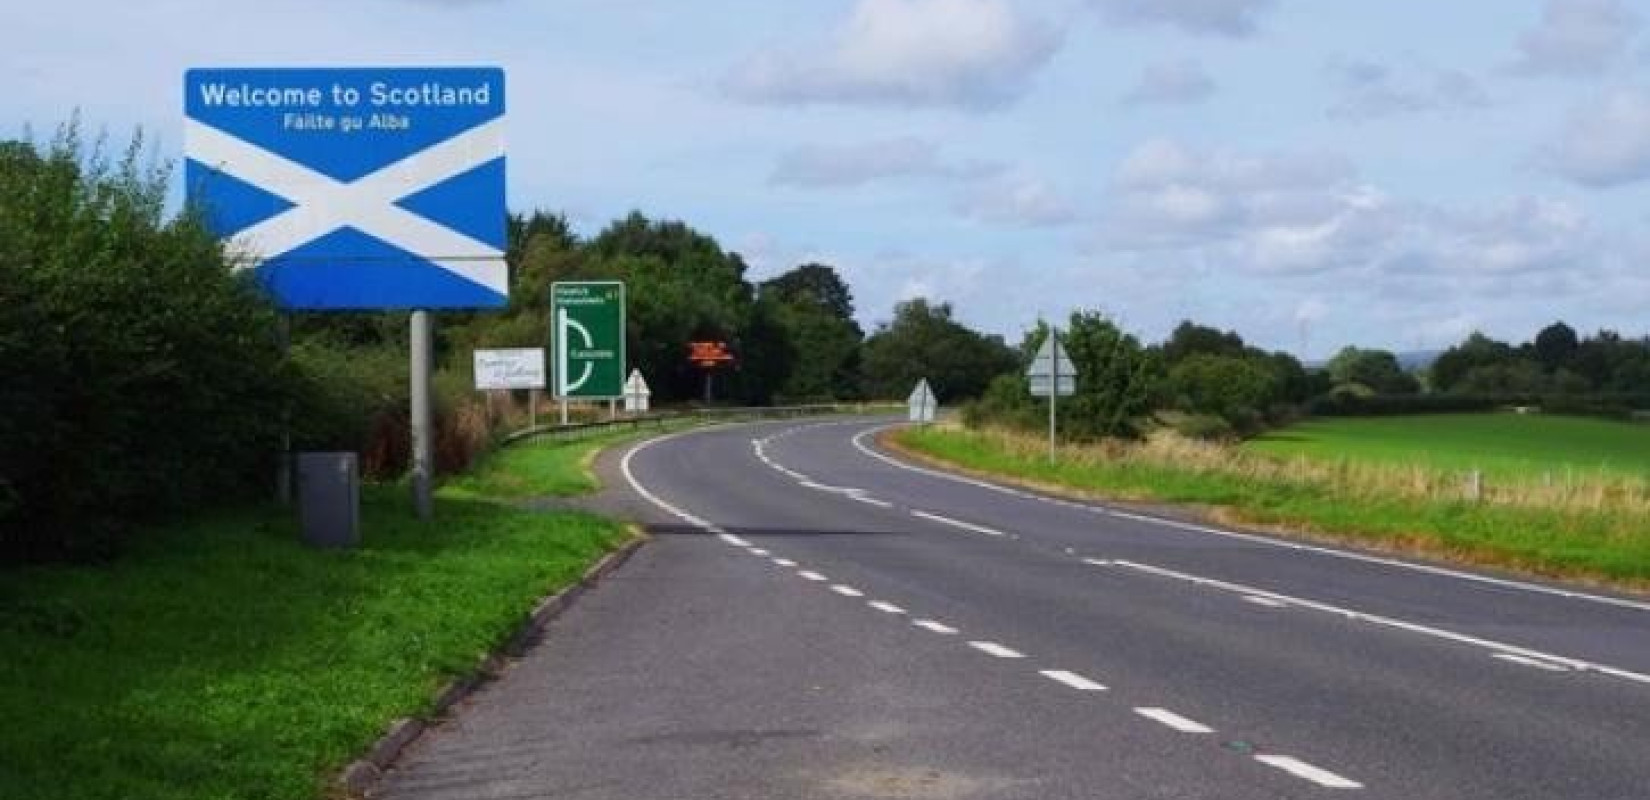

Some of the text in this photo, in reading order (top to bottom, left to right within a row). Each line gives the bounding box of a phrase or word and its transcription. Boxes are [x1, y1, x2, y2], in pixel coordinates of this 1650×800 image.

[202, 81, 490, 106] Welcome to Scotland
[340, 117, 362, 132] gu
[368, 112, 410, 129] Alba
